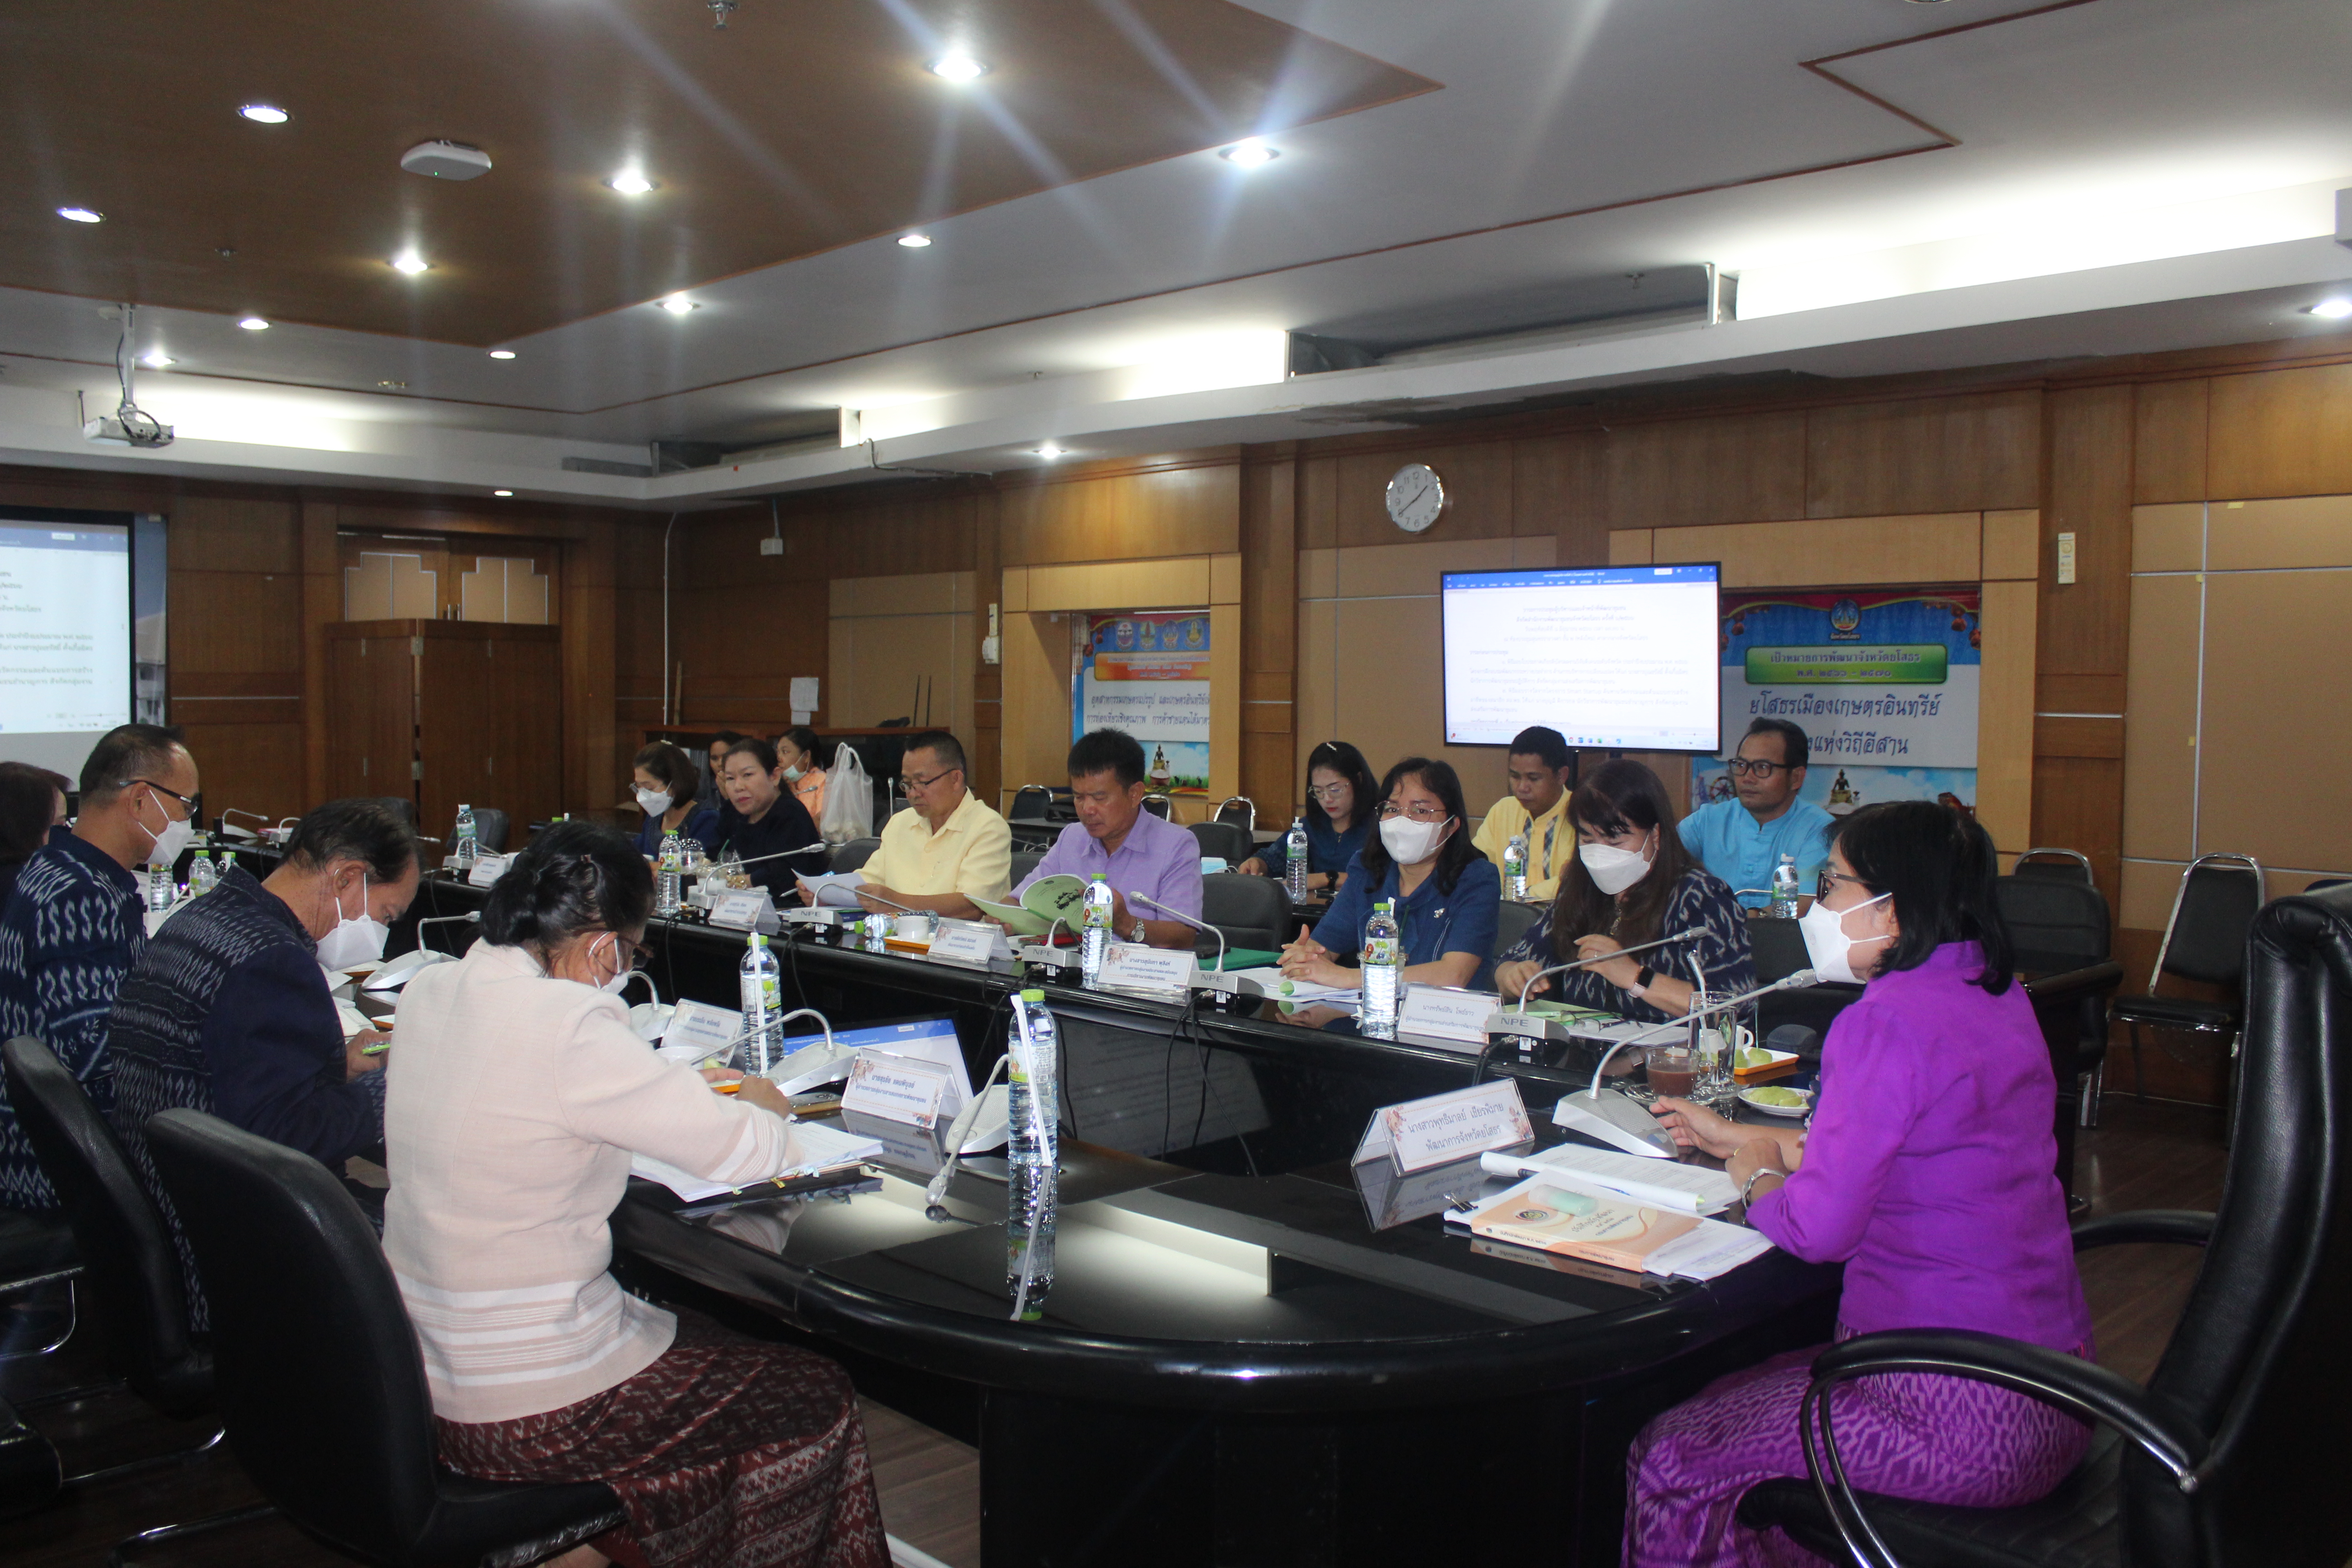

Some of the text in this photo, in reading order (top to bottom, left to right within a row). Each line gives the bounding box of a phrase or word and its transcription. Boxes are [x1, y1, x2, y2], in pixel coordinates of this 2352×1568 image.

[1412, 471, 1420, 480] 12
[1397, 486, 1404, 494] 10
[1395, 498, 1401, 506] 9
[1435, 494, 1439, 502] 3
[1398, 509, 1404, 518] 8
[1405, 517, 1411, 526] 7
[1414, 519, 1420, 527] 6
[1424, 515, 1429, 524] 5
[1771, 649, 1921, 663] เป้าหมายการพัฒนาจังหวัดยโสธร
[1749, 691, 1942, 717] ยโสธรเมืองเกษตรอินทรีย์
[1033, 949, 1054, 957] NPE
[1200, 974, 1224, 983] NPE
[1500, 1017, 1529, 1027] NPE
[1408, 1108, 1467, 1133] นางสาวพุทธิมาลย์
[1426, 1124, 1501, 1151] พัฒนาการจังหวัดยโสธร
